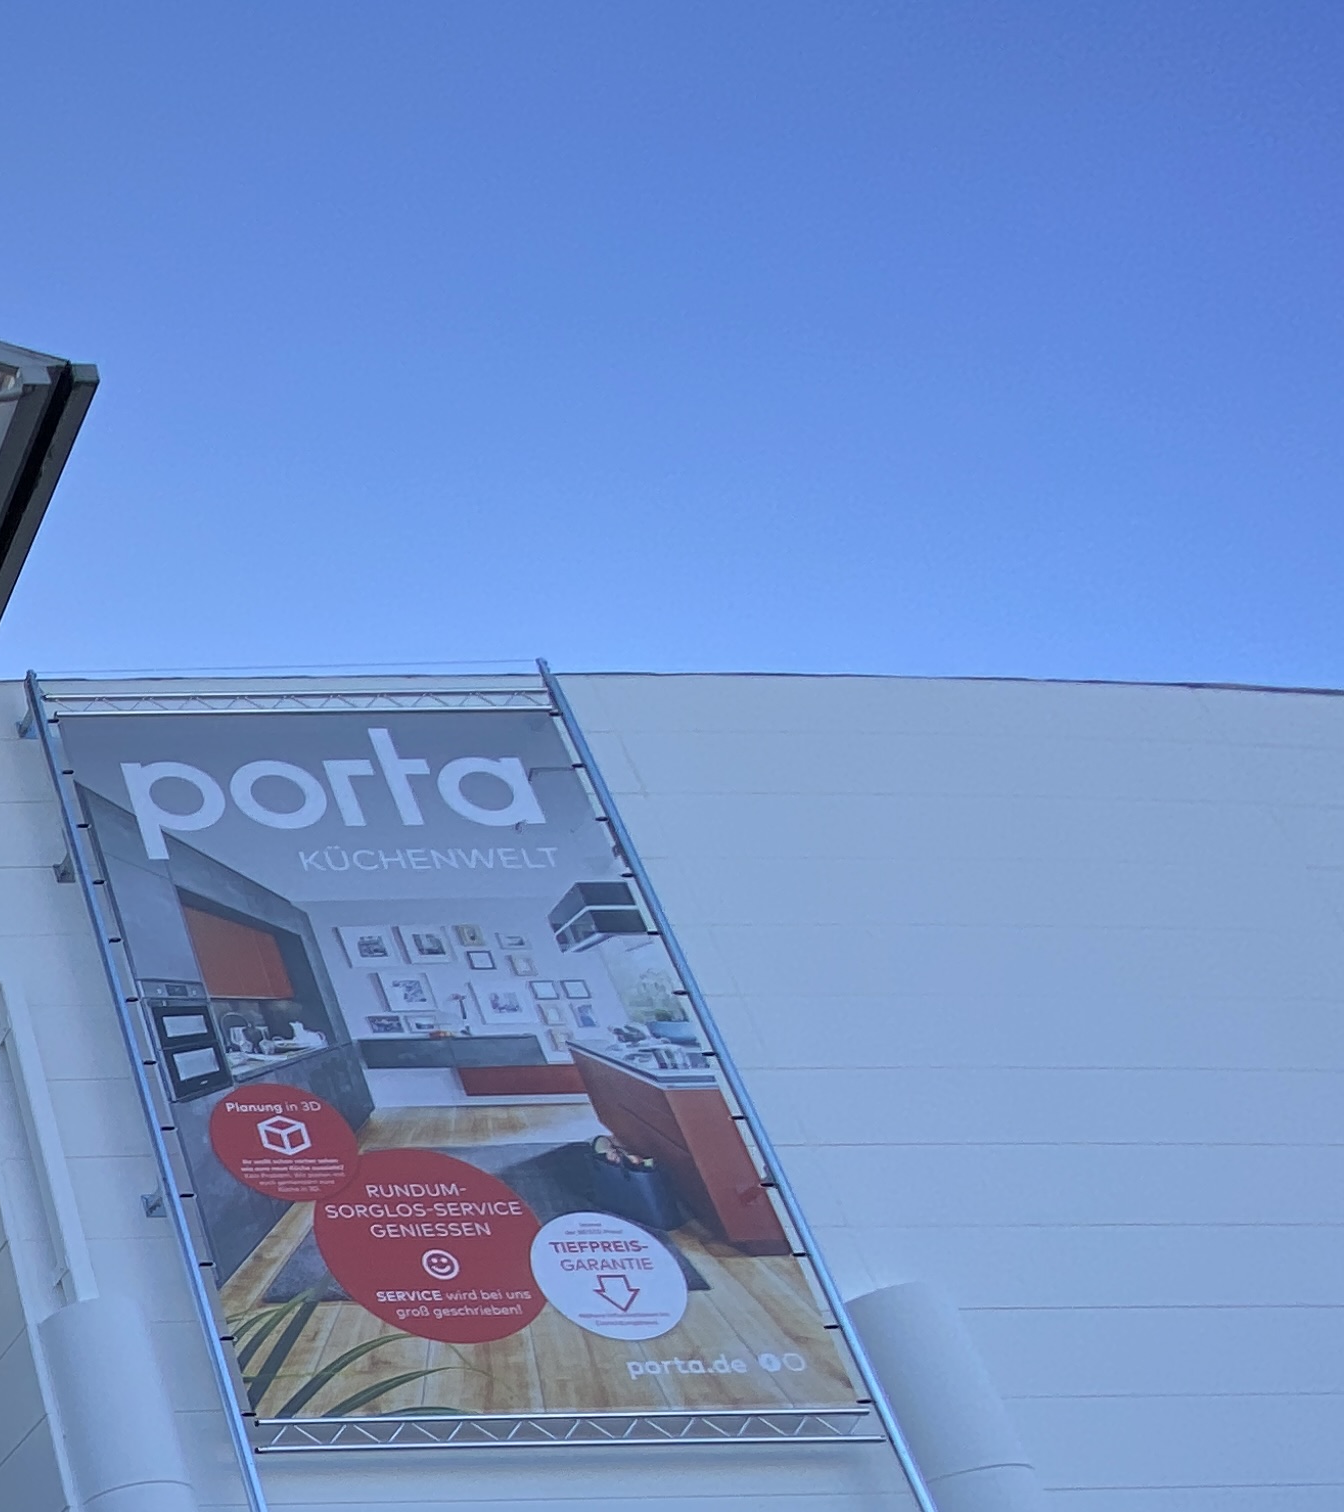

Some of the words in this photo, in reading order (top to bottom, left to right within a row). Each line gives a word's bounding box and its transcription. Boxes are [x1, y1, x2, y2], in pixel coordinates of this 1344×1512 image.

[119, 728, 546, 861] porta
[298, 846, 559, 873] KÜCHENWELT
[225, 1102, 283, 1114] Planung
[286, 1101, 298, 1112] in
[301, 1101, 322, 1112] 3D
[366, 1183, 466, 1198] RUNDUM-
[325, 1201, 523, 1219] SORGLOS-SERVICE
[370, 1222, 492, 1238] GENIESSEN
[548, 1240, 649, 1254] TIEFPREIS-
[560, 1258, 654, 1271] GARANTIE
[376, 1290, 443, 1302] SERVICE
[446, 1289, 478, 1300] wird
[481, 1289, 503, 1300] bei
[506, 1291, 532, 1300] uns
[396, 1306, 430, 1319] groß
[433, 1304, 523, 1319] geschrieben!
[626, 1353, 747, 1380] porta.de
